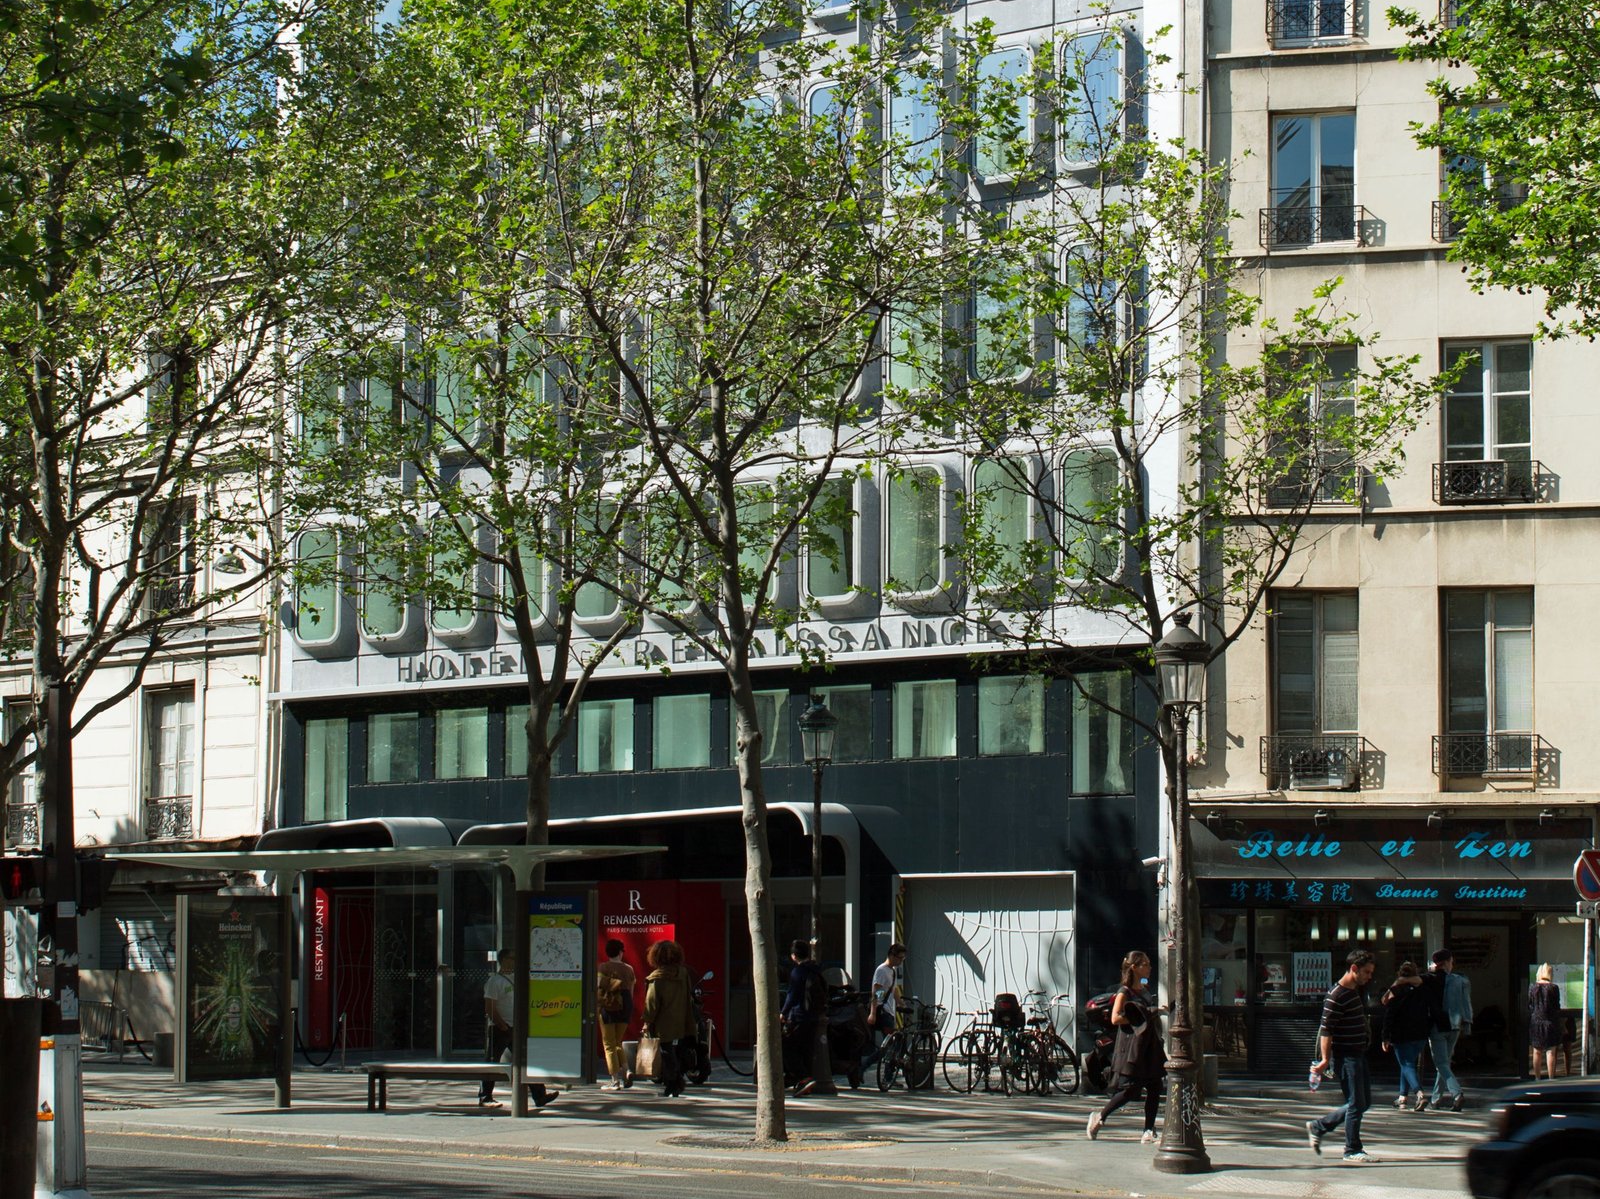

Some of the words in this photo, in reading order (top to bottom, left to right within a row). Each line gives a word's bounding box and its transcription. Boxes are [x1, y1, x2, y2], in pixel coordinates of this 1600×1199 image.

[1238, 828, 1341, 859] Belle
[1380, 836, 1416, 858] et
[1454, 831, 1532, 859] Zen
[628, 889, 646, 911] R
[1230, 880, 1353, 902] 珍珠美容院
[1375, 883, 1439, 899] Beaute
[1454, 885, 1527, 899] Institut
[218, 922, 252, 931] Heineken
[603, 914, 668, 925] RENAISSANCE
[314, 896, 324, 981] RESTAURANT
